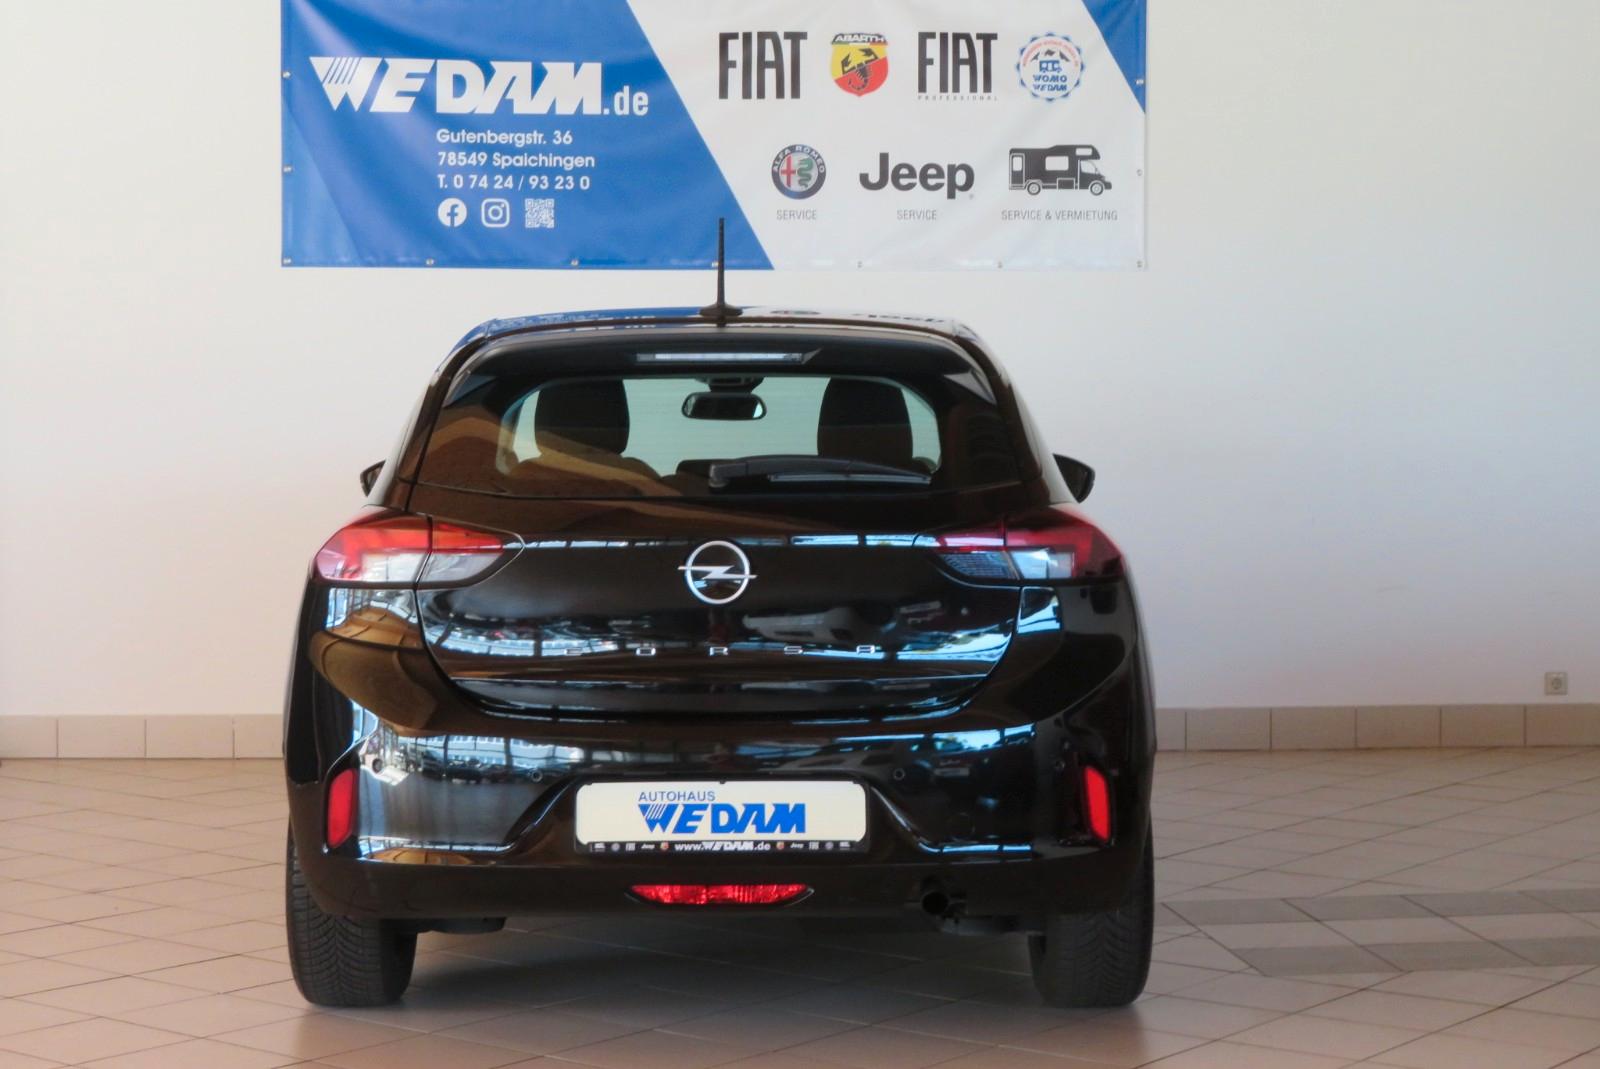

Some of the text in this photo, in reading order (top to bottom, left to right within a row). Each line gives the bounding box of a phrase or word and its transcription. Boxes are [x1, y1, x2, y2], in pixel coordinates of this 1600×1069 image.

[834, 33, 885, 43] ABARTH
[718, 31, 807, 100] FIAT
[918, 32, 998, 93] FIAT
[1033, 75, 1068, 83] WOMO
[1033, 84, 1068, 92] WEDAM
[436, 128, 573, 148] Gutenbergstr. 36
[438, 151, 596, 170] 78549 Spaichingen
[773, 145, 826, 173] ALFA ROMEO
[437, 174, 450, 190] T.
[453, 175, 464, 189] 0
[469, 175, 488, 189] 74
[494, 175, 514, 190] 24
[529, 176, 549, 190] 93
[554, 176, 575, 190] 23
[579, 176, 591, 190] 0
[859, 152, 975, 200] Jeep
[776, 209, 817, 220] SERVICE
[896, 209, 937, 220] SERVICE
[1001, 209, 1119, 221] SERVICE & VERMIETUNG
[638, 791, 716, 802] AUTOHAUS
[638, 803, 806, 834] WEDAM
